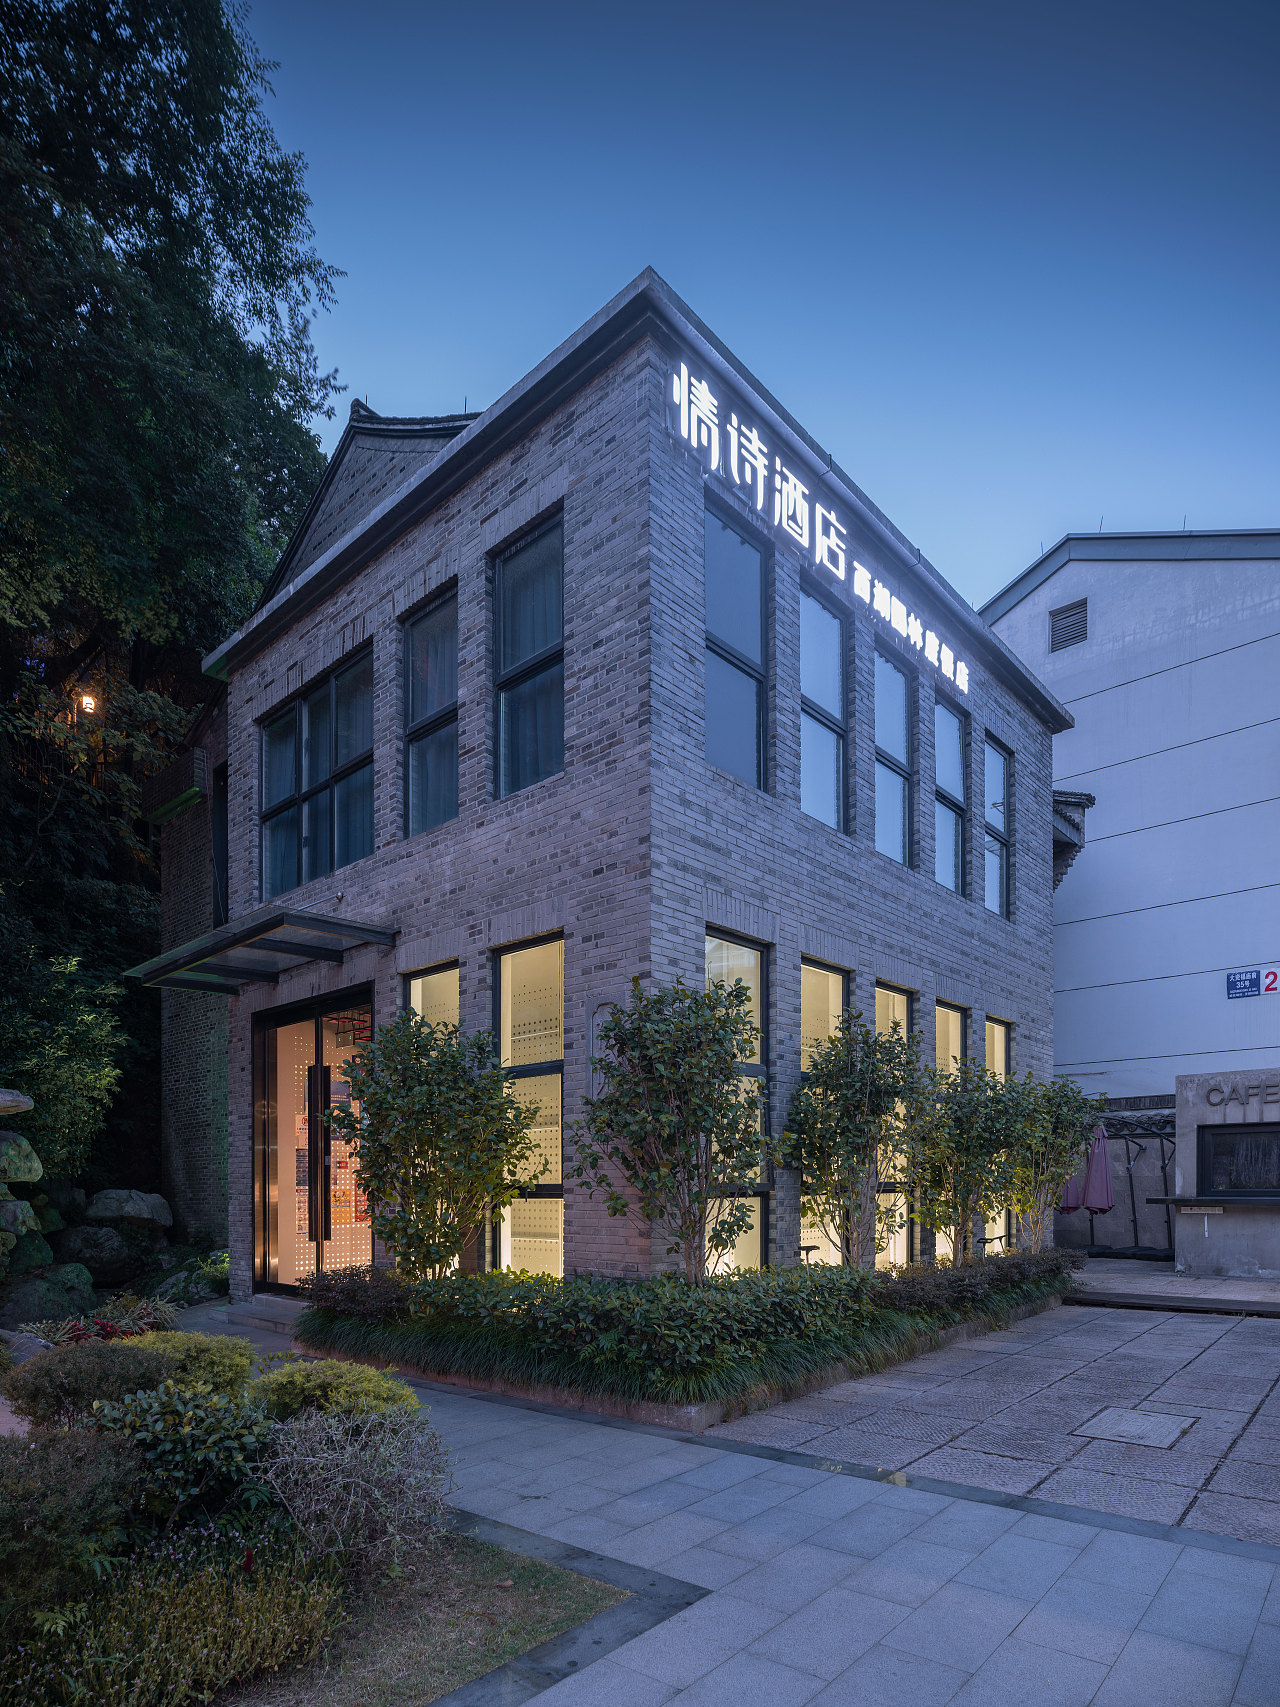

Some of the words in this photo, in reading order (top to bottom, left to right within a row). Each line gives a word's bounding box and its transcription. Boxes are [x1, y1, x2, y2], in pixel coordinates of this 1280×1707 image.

[673, 362, 847, 581] 情诗酒店
[1236, 980, 1251, 989] 35号
[1264, 971, 1278, 992] 2
[1206, 1084, 1280, 1106] CAFE
